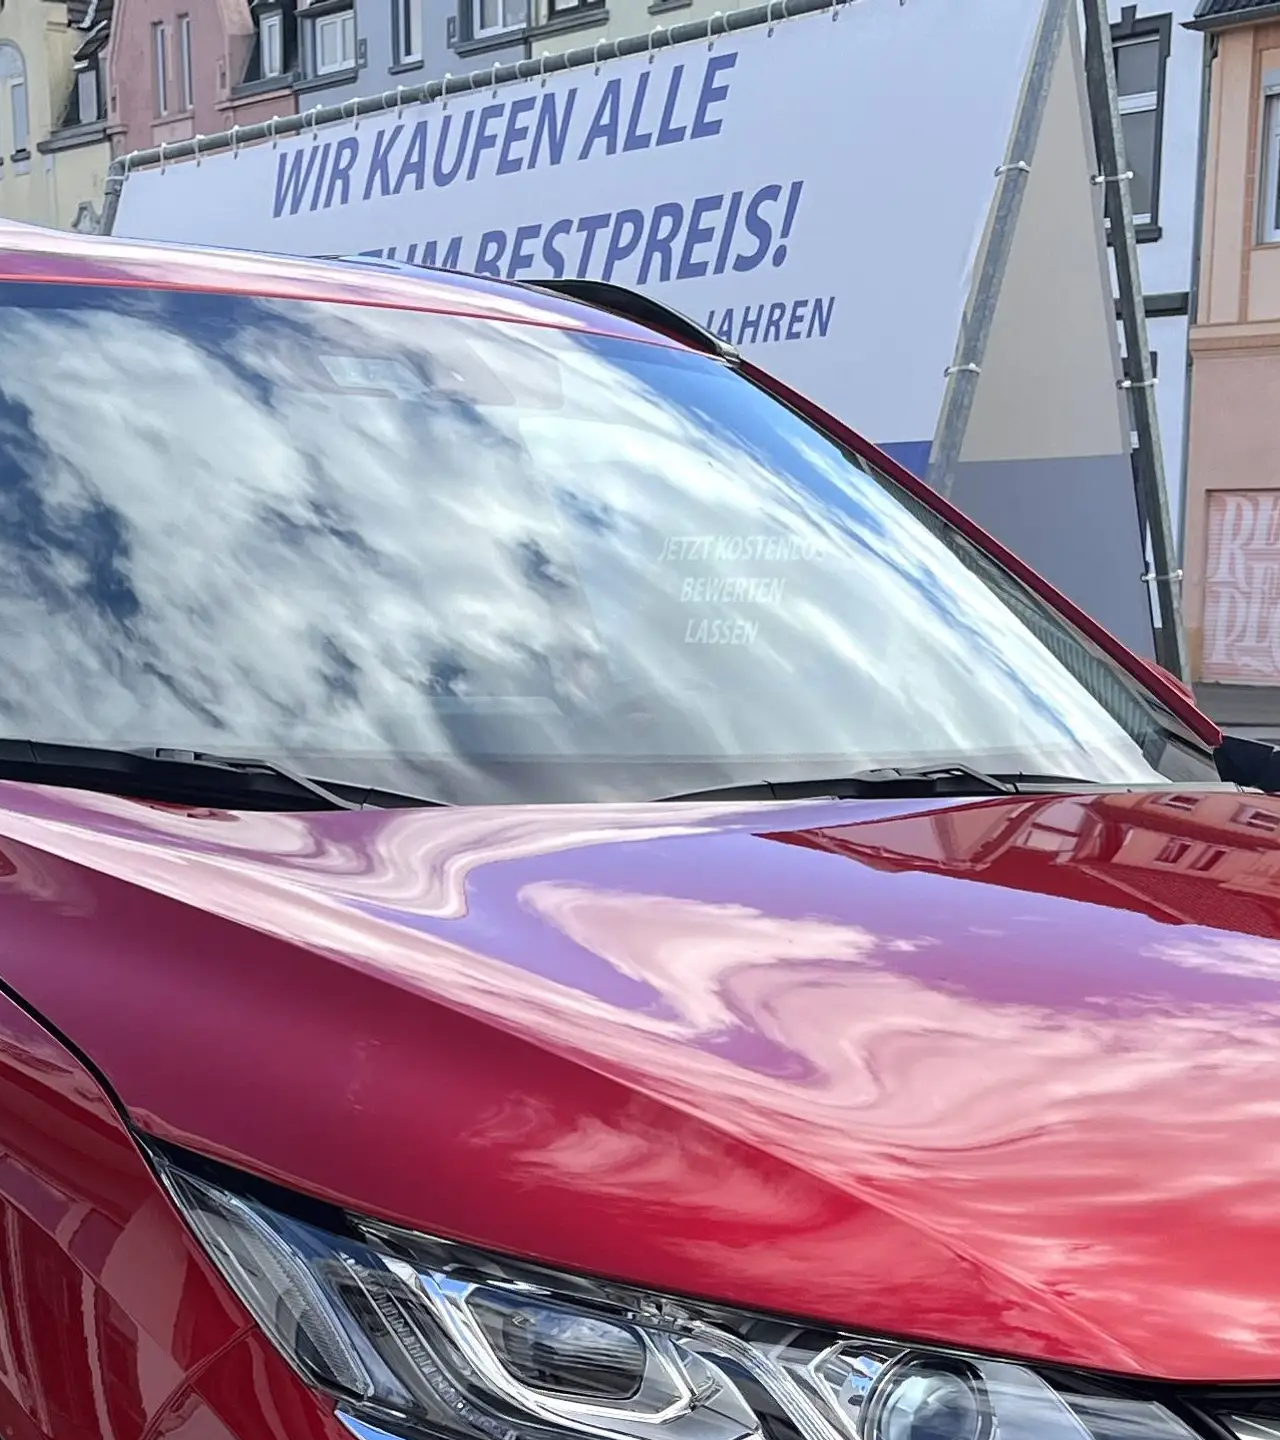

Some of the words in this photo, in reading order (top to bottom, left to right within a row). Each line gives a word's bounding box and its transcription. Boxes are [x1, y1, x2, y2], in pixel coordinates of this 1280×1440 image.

[273, 137, 357, 218] WIR
[363, 90, 577, 199] KAUFEN
[579, 52, 737, 161] ALLE
[474, 180, 803, 286] BESTPREIS!
[684, 618, 759, 645] LASSEN
